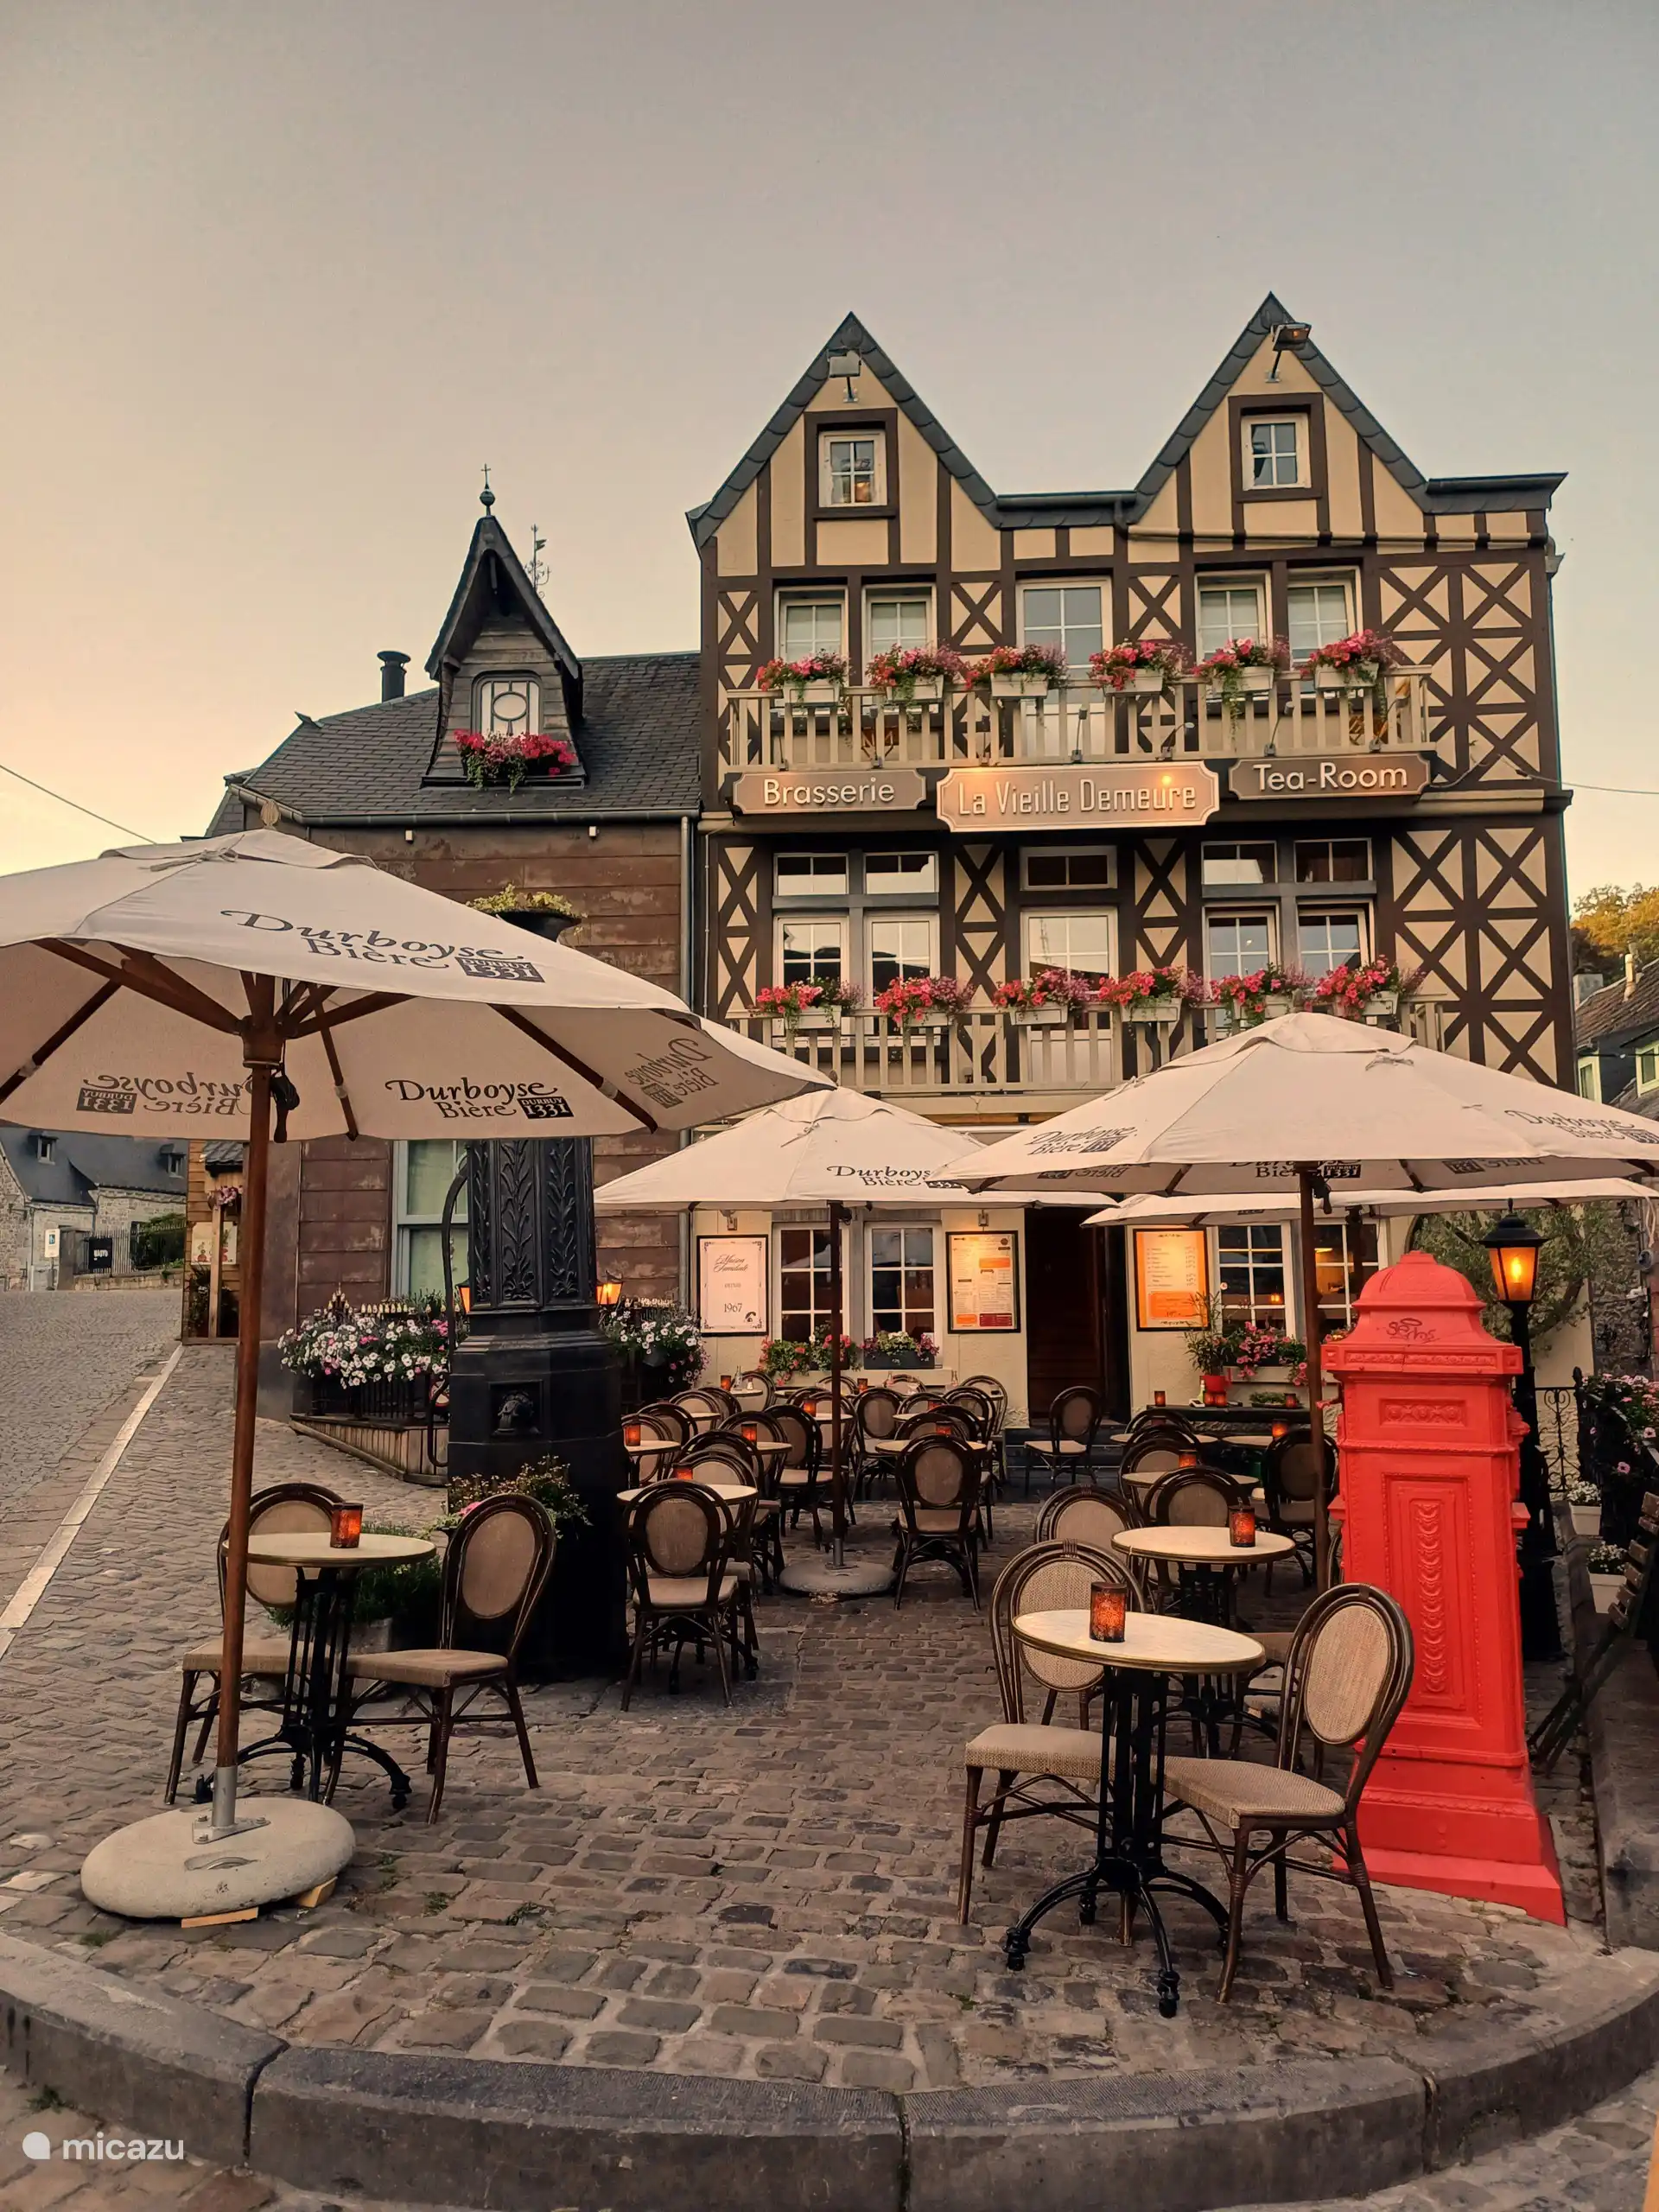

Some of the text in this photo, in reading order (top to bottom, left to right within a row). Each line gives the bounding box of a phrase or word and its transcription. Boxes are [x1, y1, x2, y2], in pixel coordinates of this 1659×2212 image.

[1253, 761, 1408, 791] Tea-Room
[764, 777, 894, 805] Brasserie
[958, 779, 1196, 816] La Vieille Demeure
[220, 909, 524, 960] Durboyse
[300, 937, 449, 969] Bière
[461, 957, 530, 969] DURBUY
[465, 963, 540, 980] 1331
[385, 1077, 558, 1106] Durboyse
[434, 1100, 517, 1119] Bière
[524, 1103, 569, 1117] 1331
[826, 1165, 931, 1182] Durboys
[859, 1175, 923, 1186] Bière
[723, 1303, 743, 1313] 1967
